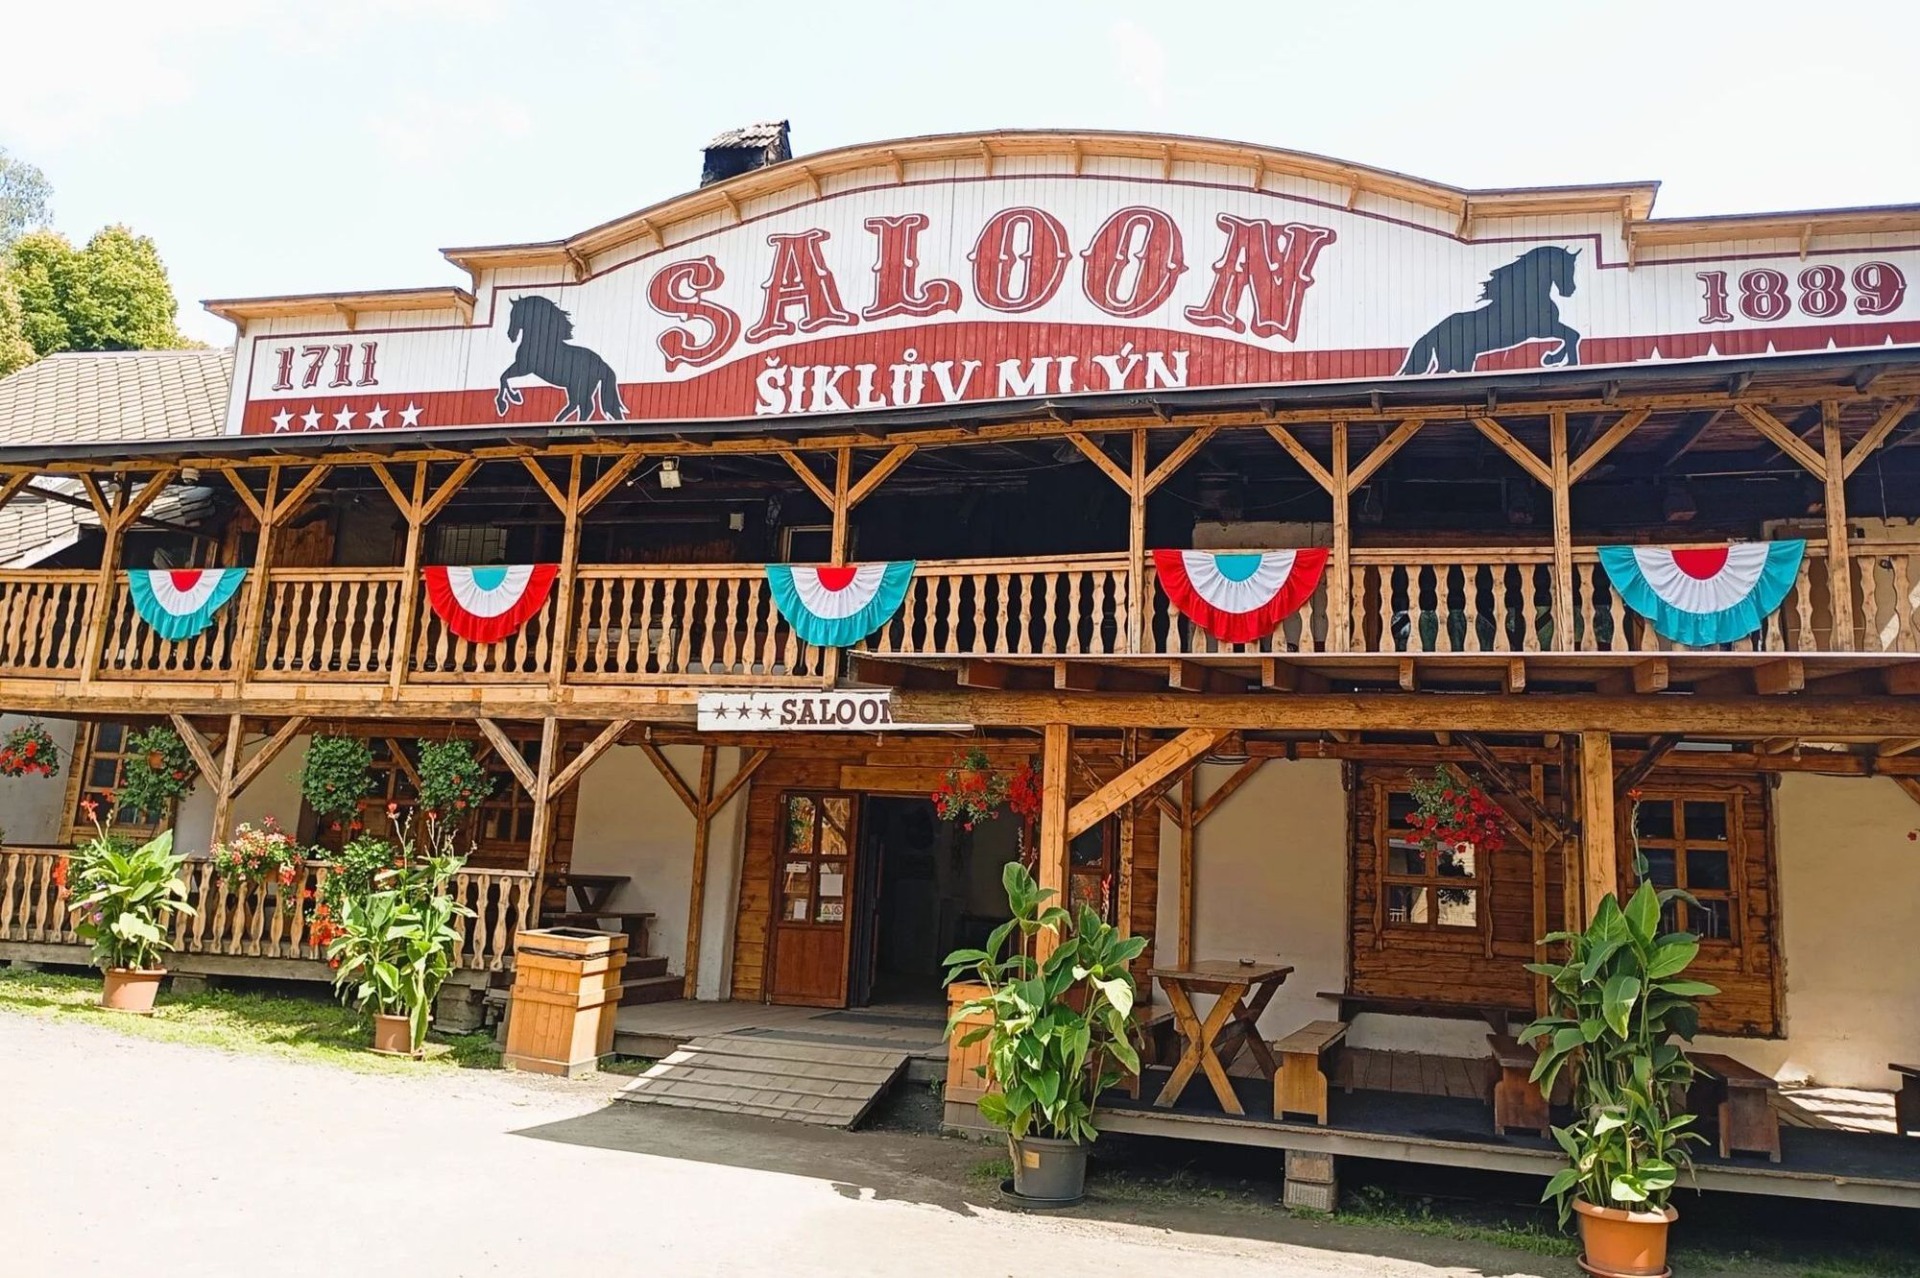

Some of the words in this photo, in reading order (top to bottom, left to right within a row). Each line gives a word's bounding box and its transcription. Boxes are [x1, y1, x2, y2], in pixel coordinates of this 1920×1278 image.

[646, 205, 1336, 374] SALOON
[1697, 261, 1907, 324] 1889
[271, 341, 380, 391] 1711
[755, 348, 982, 416] ŠIKLŮV
